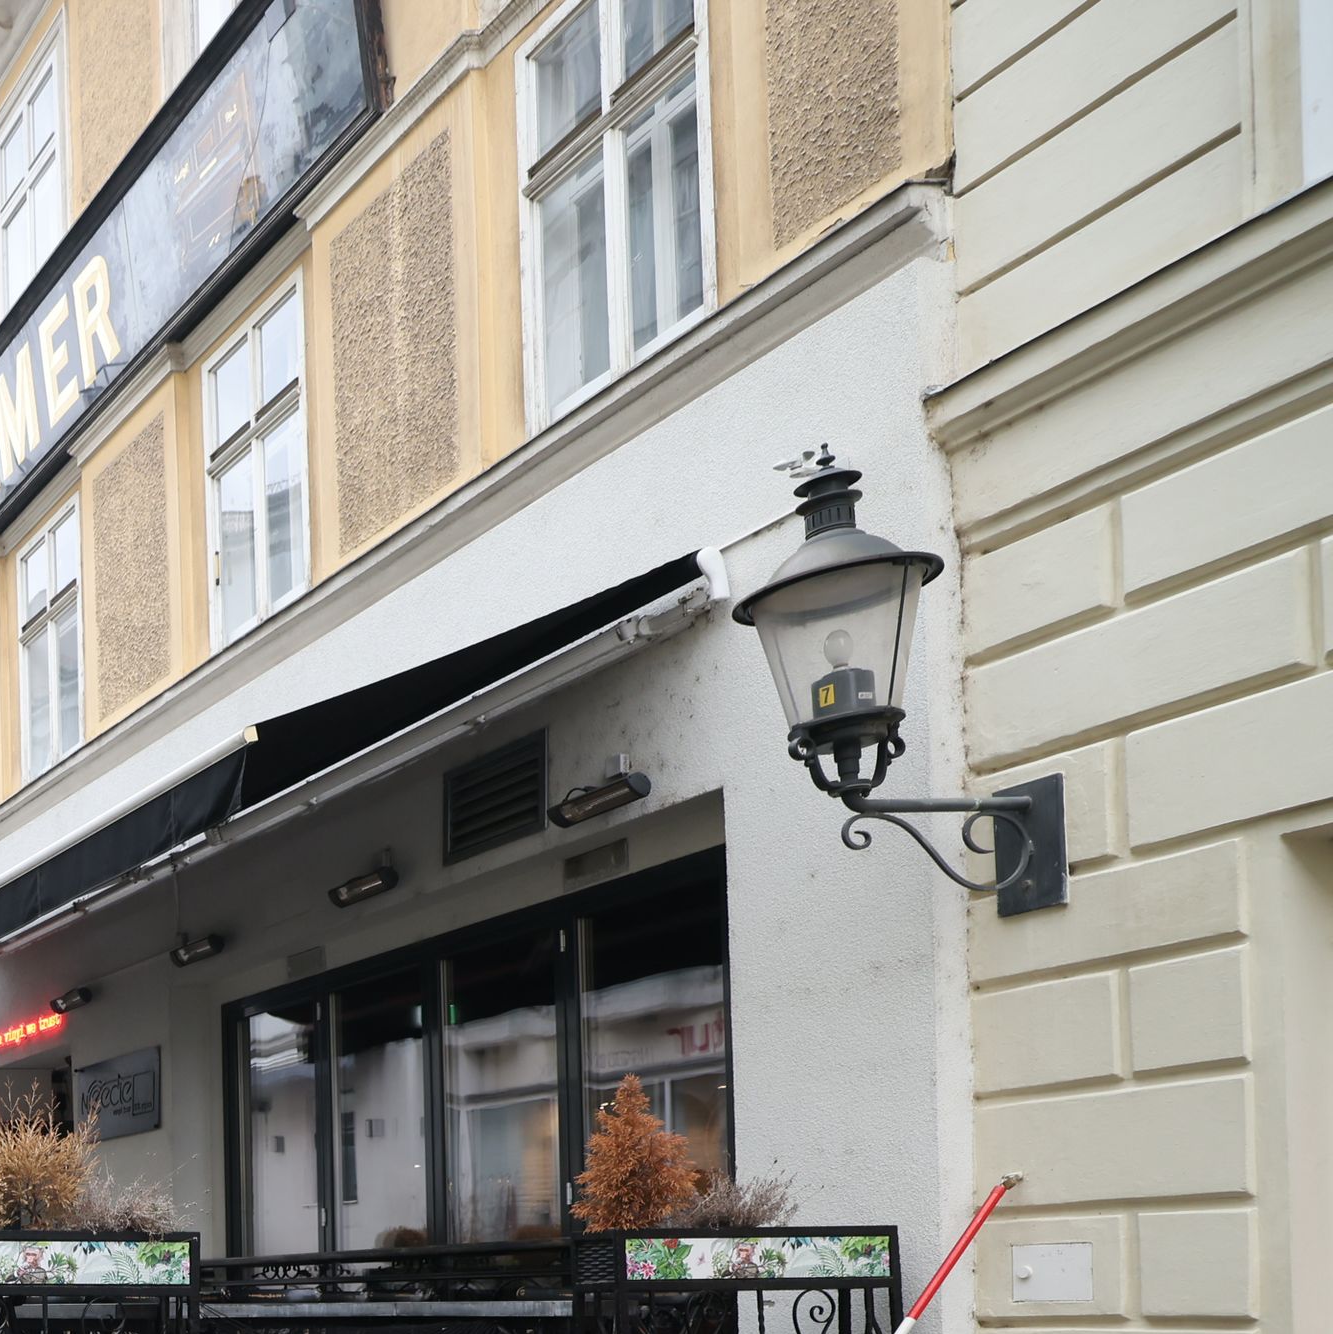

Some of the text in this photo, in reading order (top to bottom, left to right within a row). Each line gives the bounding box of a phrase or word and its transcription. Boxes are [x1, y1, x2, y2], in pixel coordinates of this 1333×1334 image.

[822, 687, 829, 704] 7
[4, 1023, 26, 1046] vinyl
[26, 1023, 37, 1035] we
